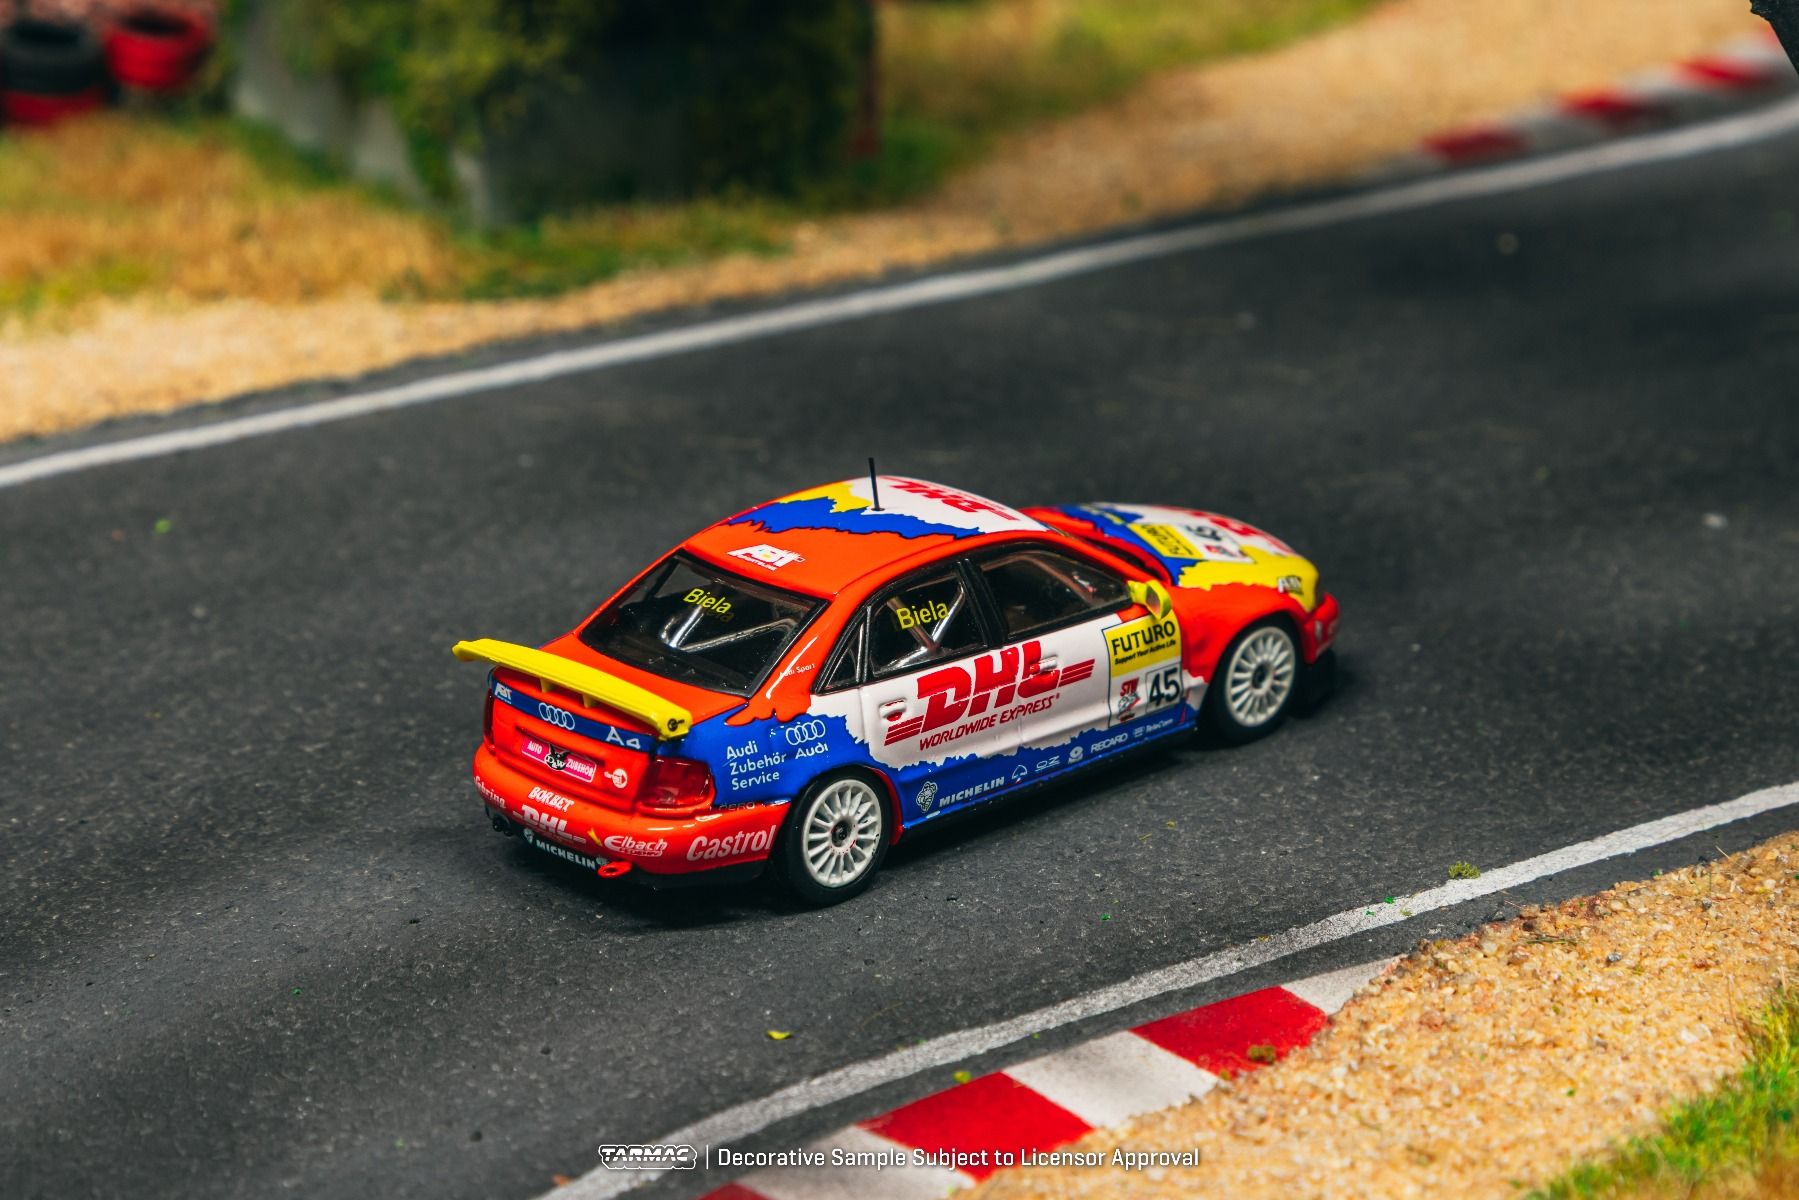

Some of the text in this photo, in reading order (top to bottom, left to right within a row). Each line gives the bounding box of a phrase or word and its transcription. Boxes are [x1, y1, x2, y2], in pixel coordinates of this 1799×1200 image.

[683, 588, 732, 615] Biela
[895, 600, 950, 629] Biela
[1111, 620, 1175, 656] FUTURO
[796, 663, 815, 674] Sport
[917, 640, 1060, 733] DHL
[1149, 667, 1180, 706] 45
[919, 696, 1055, 750] WORLDWIDE EXPRESS
[527, 740, 543, 755] AUTO
[605, 725, 641, 750] A4
[726, 740, 758, 760] Audi
[795, 742, 829, 760] Audi
[729, 751, 787, 776] Zubehör
[939, 776, 1005, 807] MICHELIN
[1090, 732, 1128, 753] RECARO
[731, 771, 780, 791] Service
[528, 786, 575, 813] BORBET
[521, 804, 573, 840] DHL
[536, 839, 596, 870] MICHELIN
[686, 824, 776, 862] Castrol
